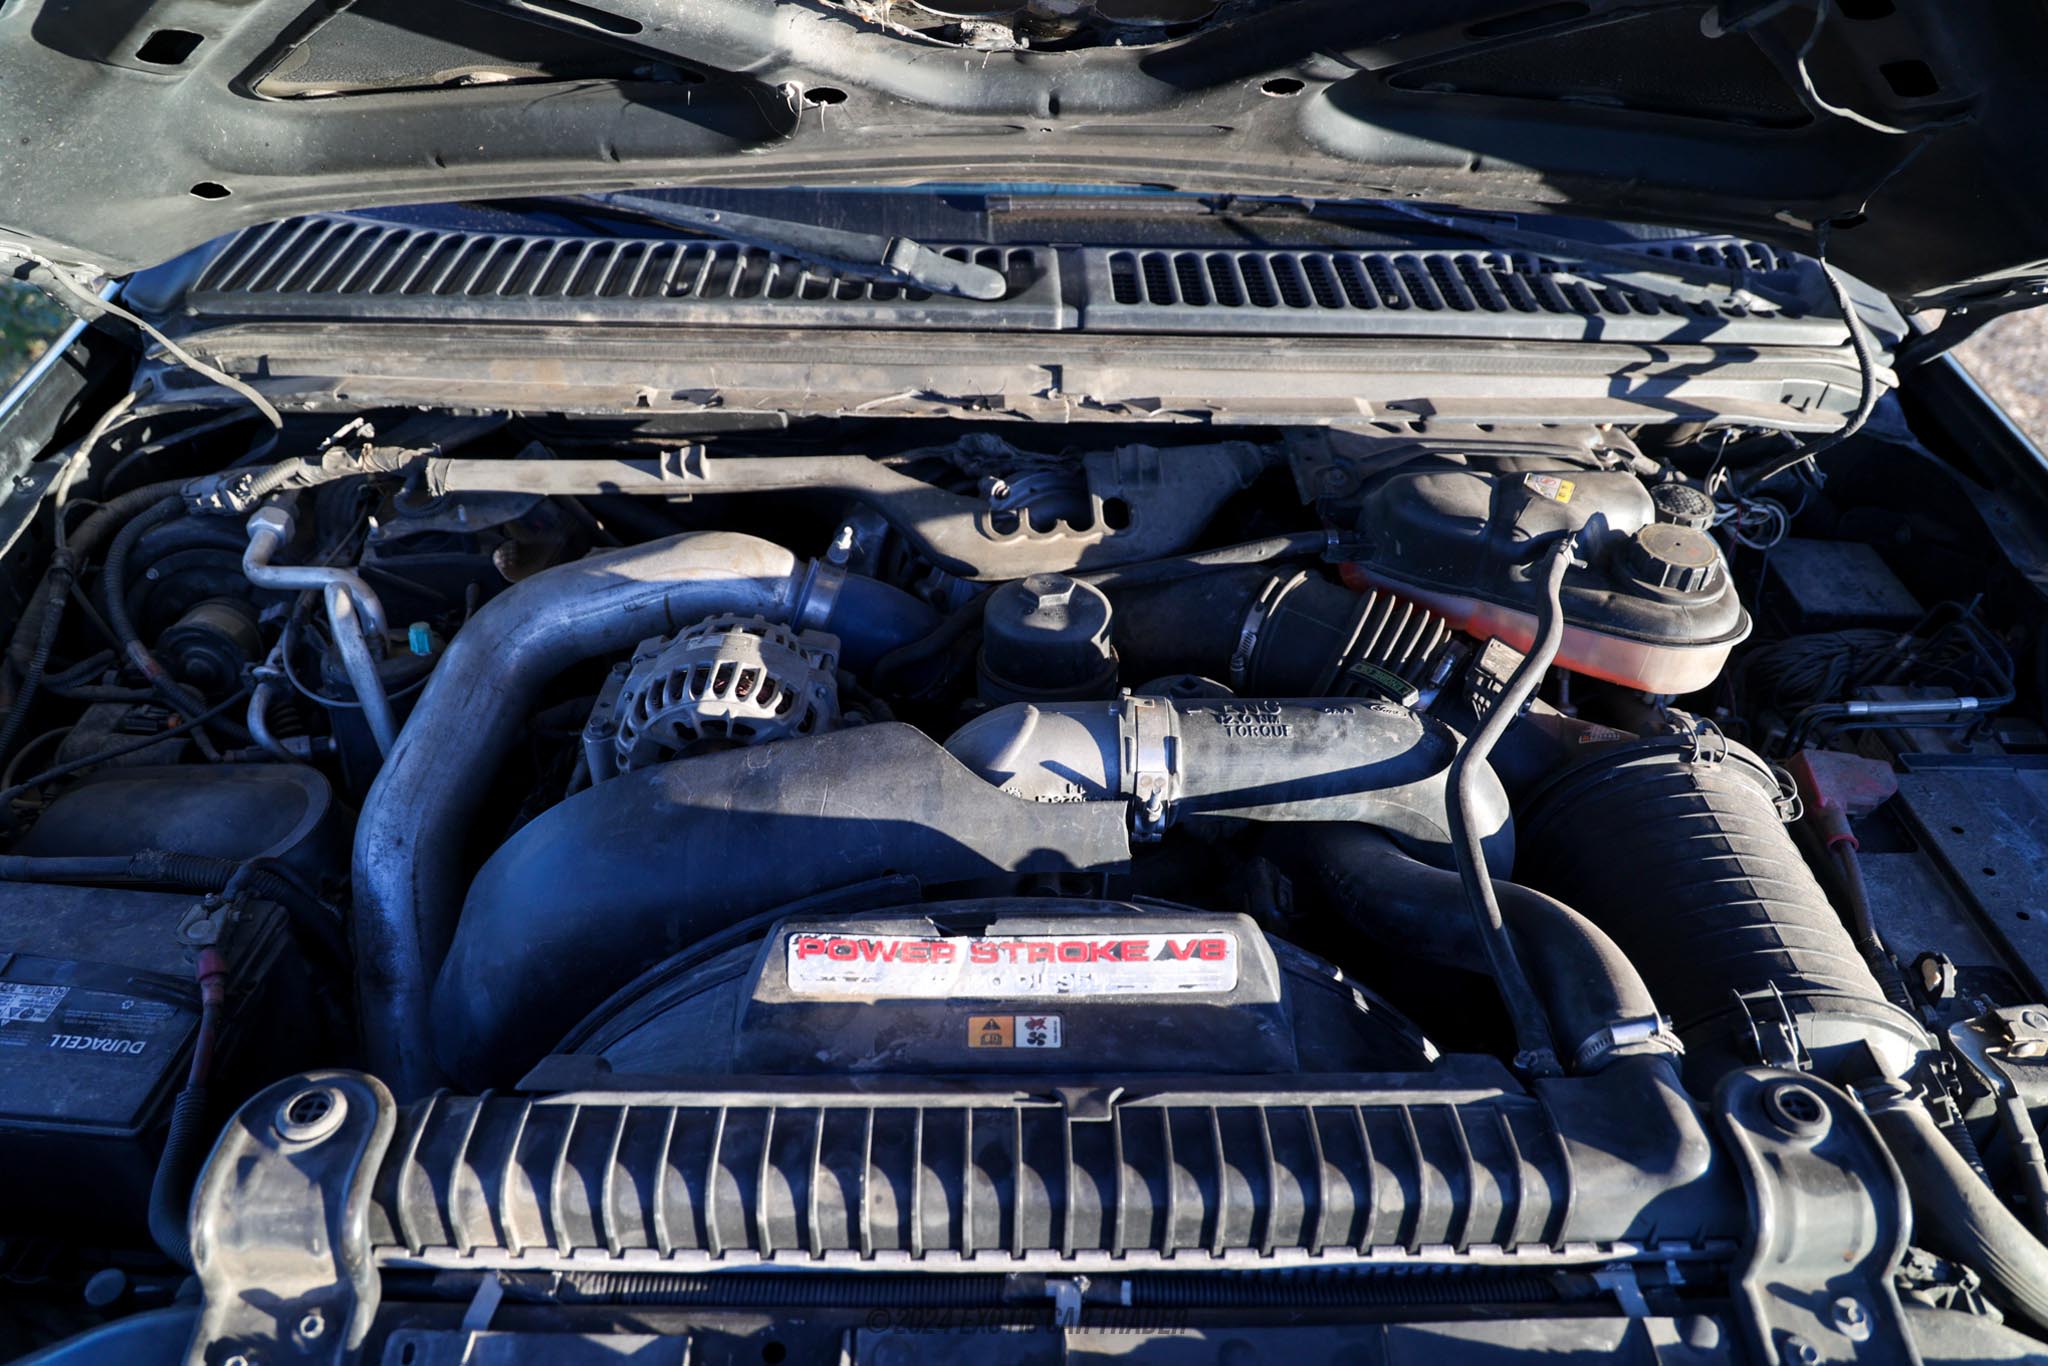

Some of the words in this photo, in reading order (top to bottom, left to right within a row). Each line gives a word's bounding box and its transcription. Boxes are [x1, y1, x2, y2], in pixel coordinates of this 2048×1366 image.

[1224, 725, 1294, 738] TORQUE
[797, 937, 957, 964] POWER
[969, 939, 1149, 963] STROKE
[1167, 938, 1227, 961] V8
[50, 1034, 146, 1054] DURACELL
